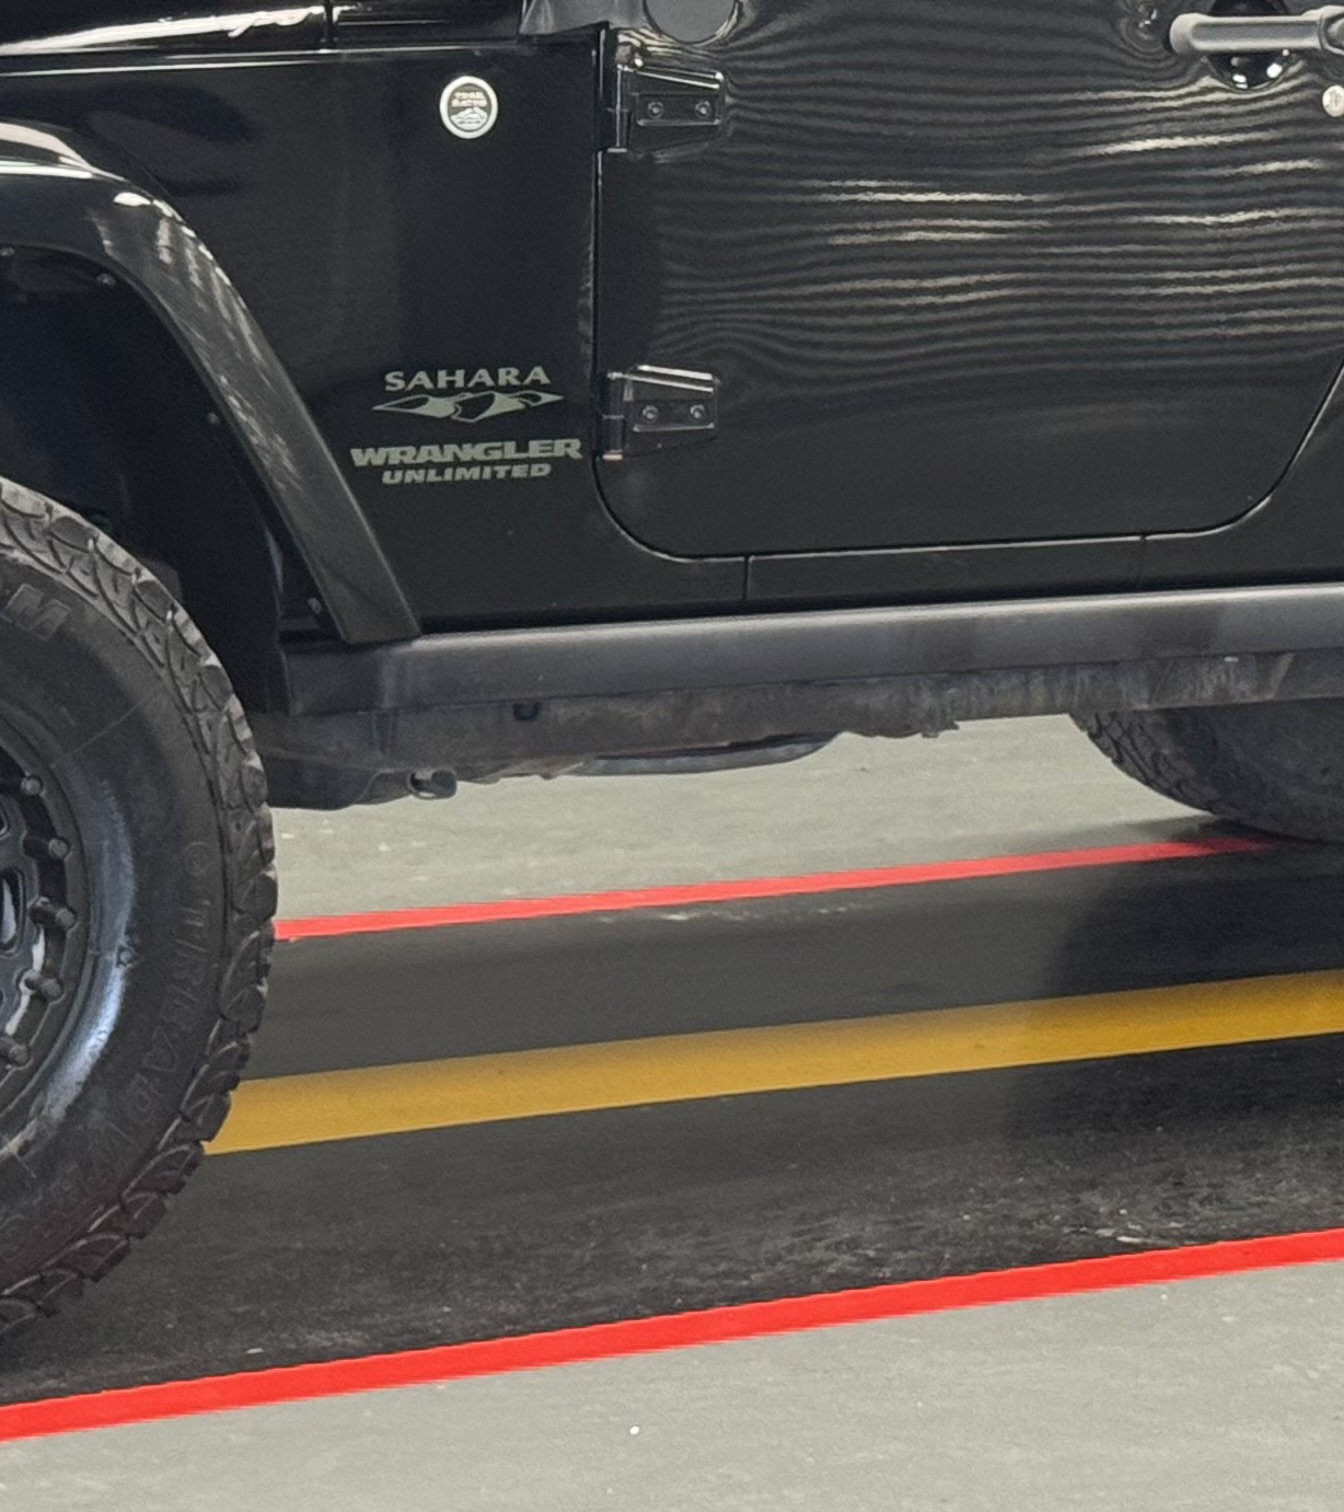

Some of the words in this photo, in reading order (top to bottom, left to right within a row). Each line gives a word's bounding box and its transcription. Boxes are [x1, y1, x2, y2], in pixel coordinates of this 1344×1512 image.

[384, 365, 552, 391] SAHARA
[350, 438, 584, 467] WRANGLER
[382, 463, 552, 485] UNLIMITED
